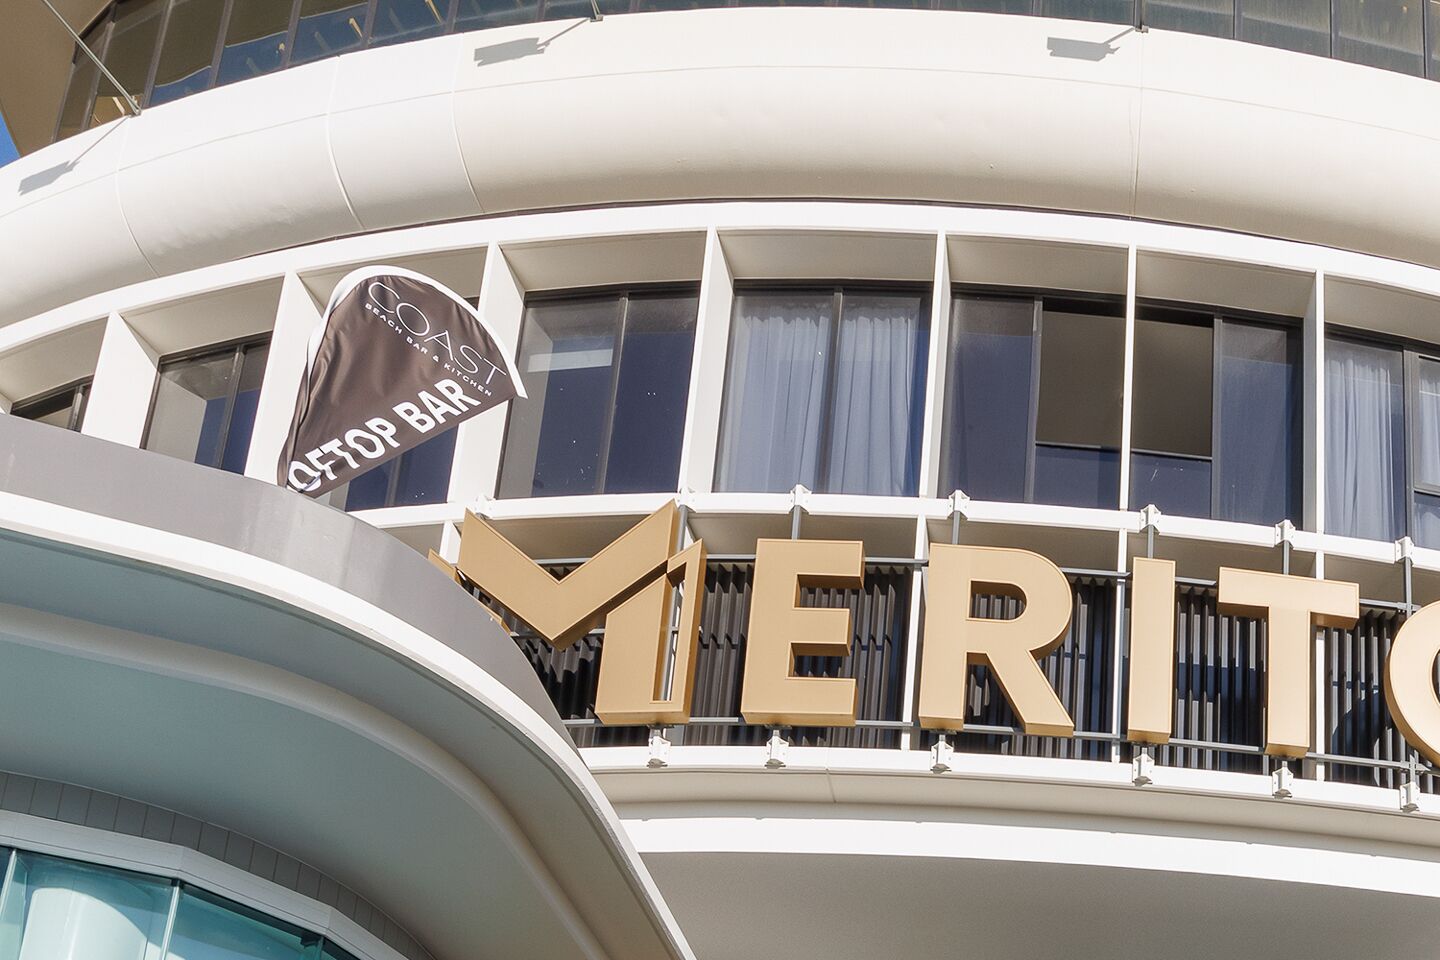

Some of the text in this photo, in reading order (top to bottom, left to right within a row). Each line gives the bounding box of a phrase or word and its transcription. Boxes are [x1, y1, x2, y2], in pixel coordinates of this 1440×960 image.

[365, 303, 492, 397] BEACH BAR & KITCHEN
[369, 282, 507, 385] COAST
[393, 378, 482, 434] BAR
